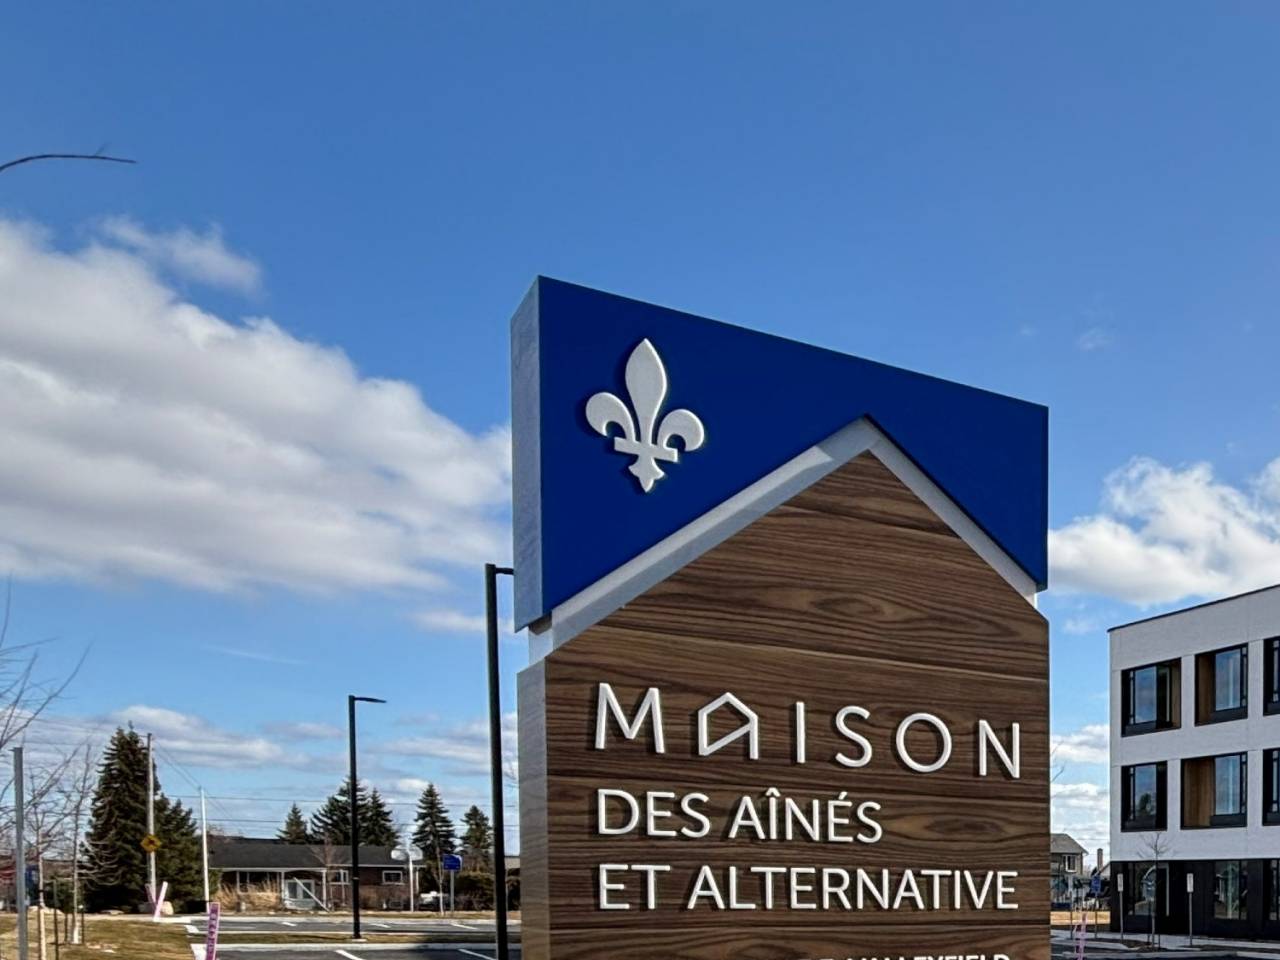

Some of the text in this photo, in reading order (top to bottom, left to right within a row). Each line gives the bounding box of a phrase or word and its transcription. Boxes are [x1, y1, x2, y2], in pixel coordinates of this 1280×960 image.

[595, 682, 1020, 779] MAISON
[598, 787, 883, 843] DES AÎNÉS
[599, 863, 1019, 910] ET ALTERNATIVE
